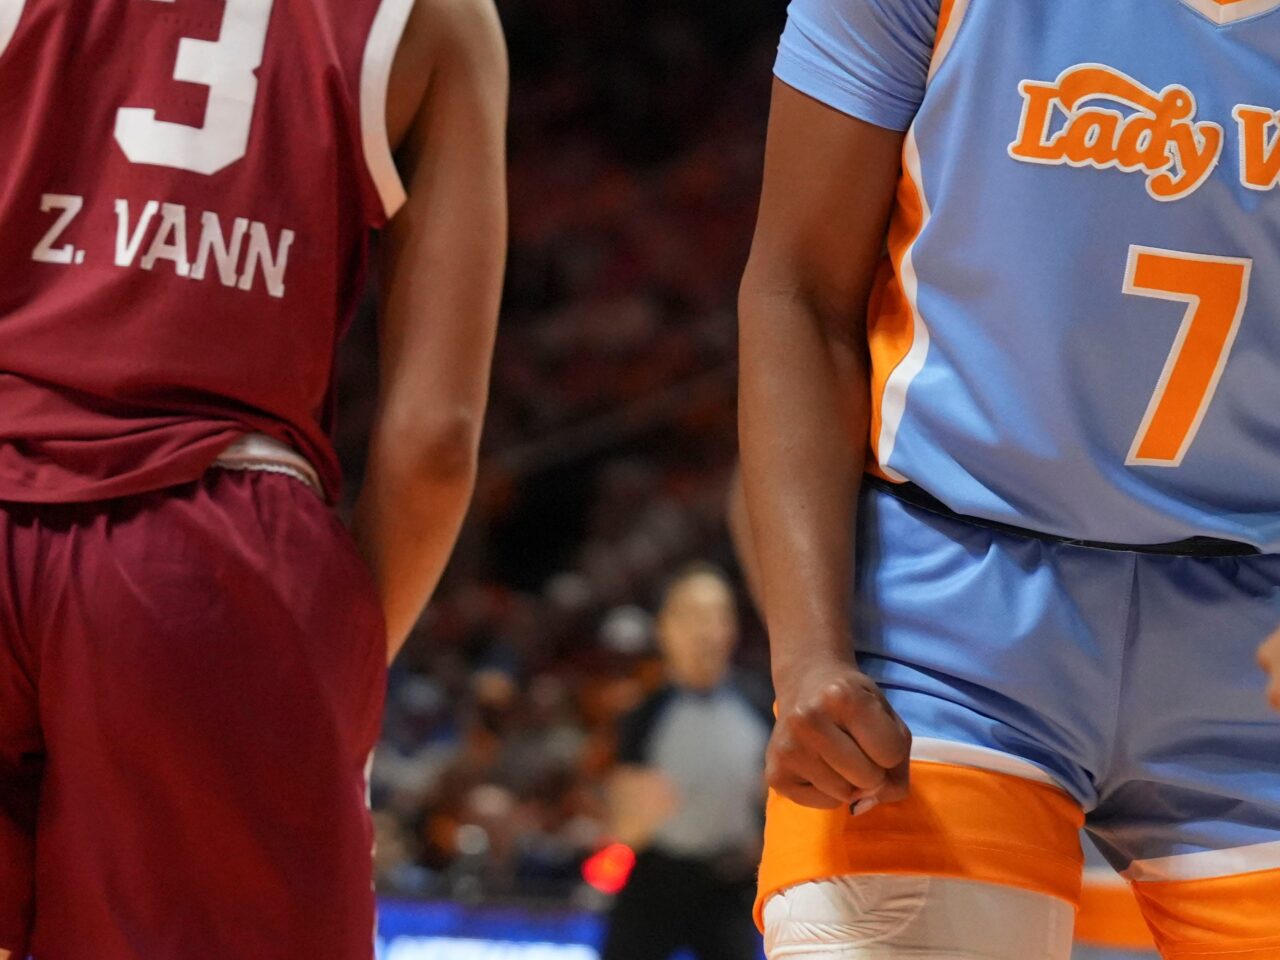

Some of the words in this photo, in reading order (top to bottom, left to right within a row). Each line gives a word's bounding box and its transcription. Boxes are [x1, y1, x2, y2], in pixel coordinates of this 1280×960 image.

[1007, 62, 1224, 202] Lady
[31, 193, 86, 265] Z.
[114, 198, 295, 298] VANN
[1121, 243, 1253, 468] 7
